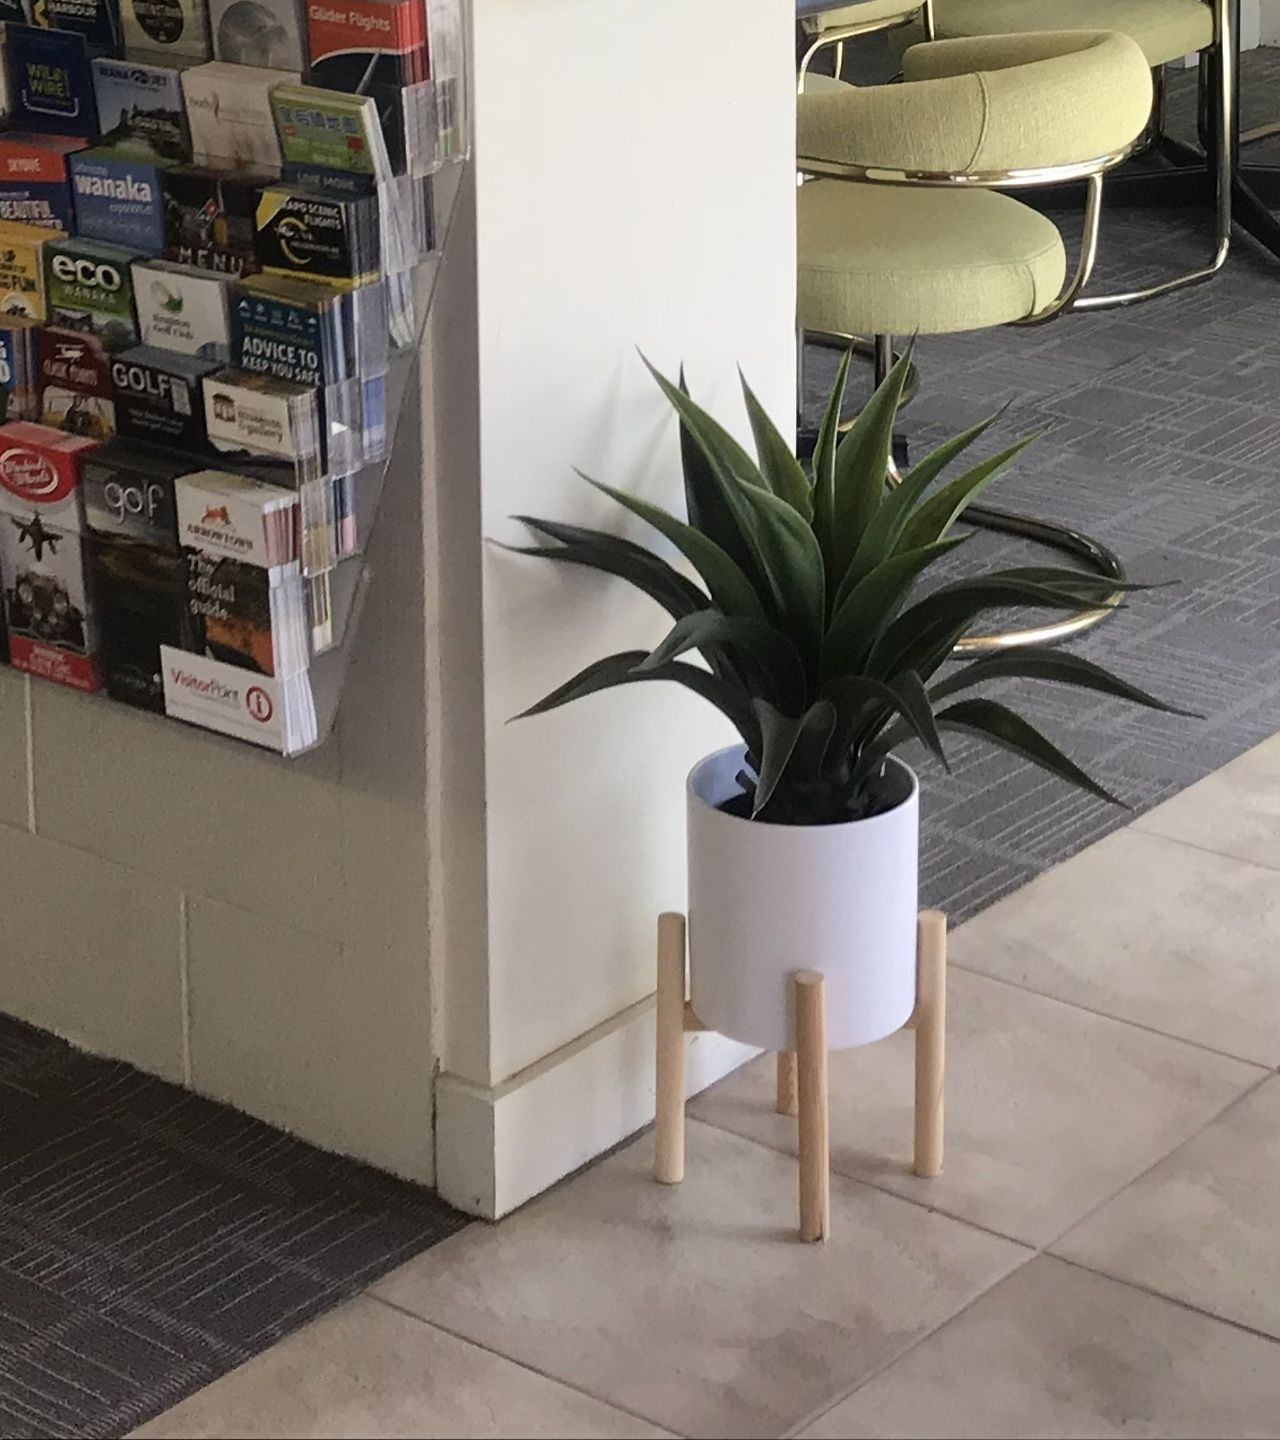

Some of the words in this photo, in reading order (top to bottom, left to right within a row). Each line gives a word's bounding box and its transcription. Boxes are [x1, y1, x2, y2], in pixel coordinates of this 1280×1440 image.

[47, 1, 98, 17] HARBOUR
[309, 4, 347, 25] Glider
[348, 11, 391, 33] Flights
[74, 174, 152, 202] wanaka
[53, 254, 121, 291] eco
[179, 245, 244, 276] MENU
[242, 336, 297, 363] ADVICE
[298, 349, 318, 368] TO
[242, 355, 269, 372] KEEP
[271, 362, 293, 378] YOU
[112, 362, 171, 398] GOLF
[103, 477, 164, 526] golf
[187, 523, 254, 551] ARROWTOWN
